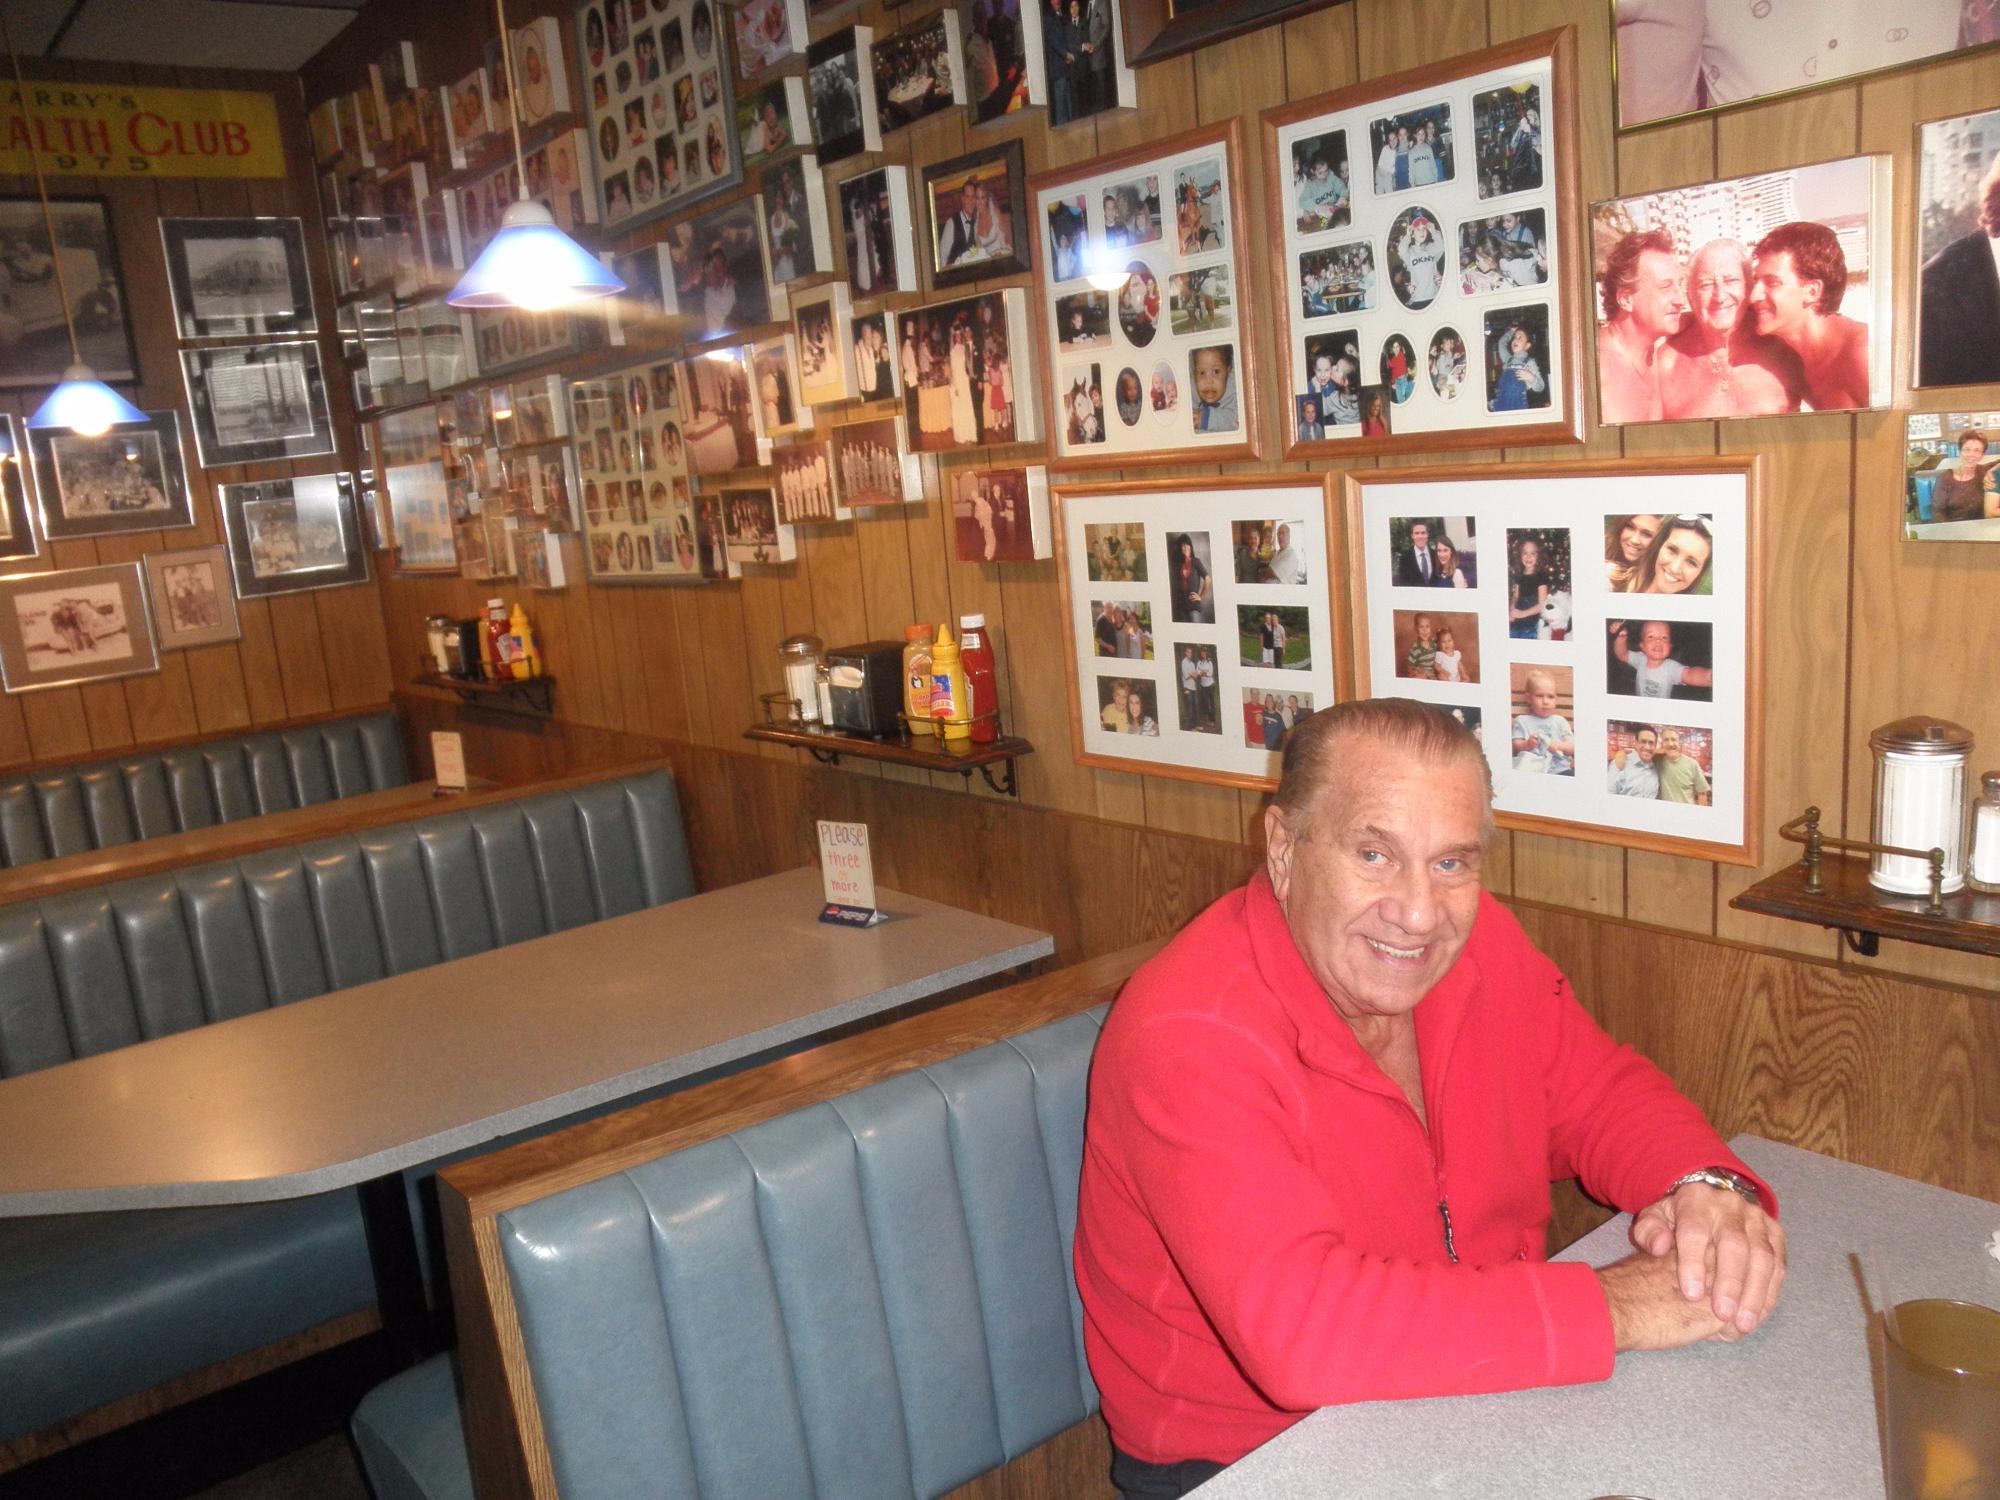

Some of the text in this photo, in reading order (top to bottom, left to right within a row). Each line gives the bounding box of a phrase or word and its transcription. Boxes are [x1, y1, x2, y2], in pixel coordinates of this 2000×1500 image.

[0, 114, 112, 155] ALTH
[827, 850, 861, 868] three
[831, 880, 859, 892] more
